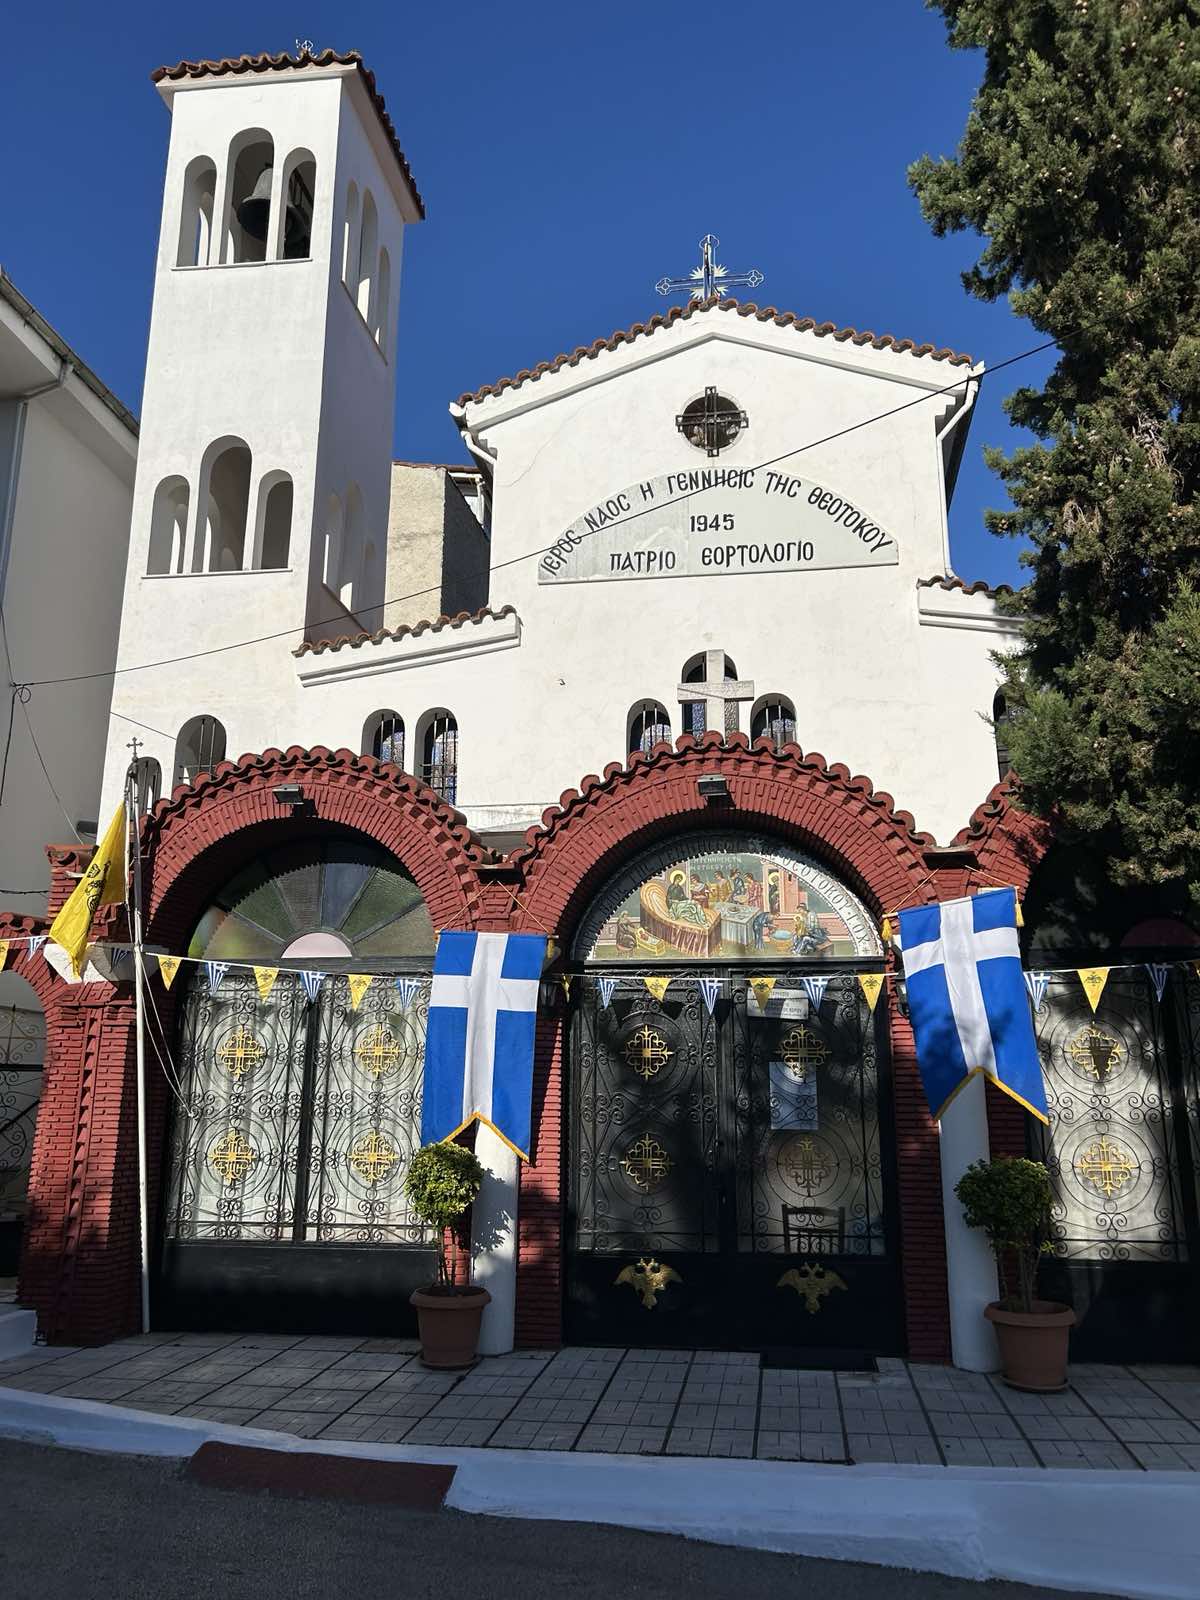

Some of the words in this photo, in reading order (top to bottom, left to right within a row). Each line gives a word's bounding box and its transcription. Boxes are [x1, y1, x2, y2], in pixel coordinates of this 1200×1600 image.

[690, 514, 735, 533] 1945
[807, 486, 894, 554] ΘΕΟΤΟΚΟΥ
[610, 550, 676, 573] ΠΑΤΡΙΟ
[701, 540, 814, 568] ΕΟΡΤΟΛΟΓΙΟ
